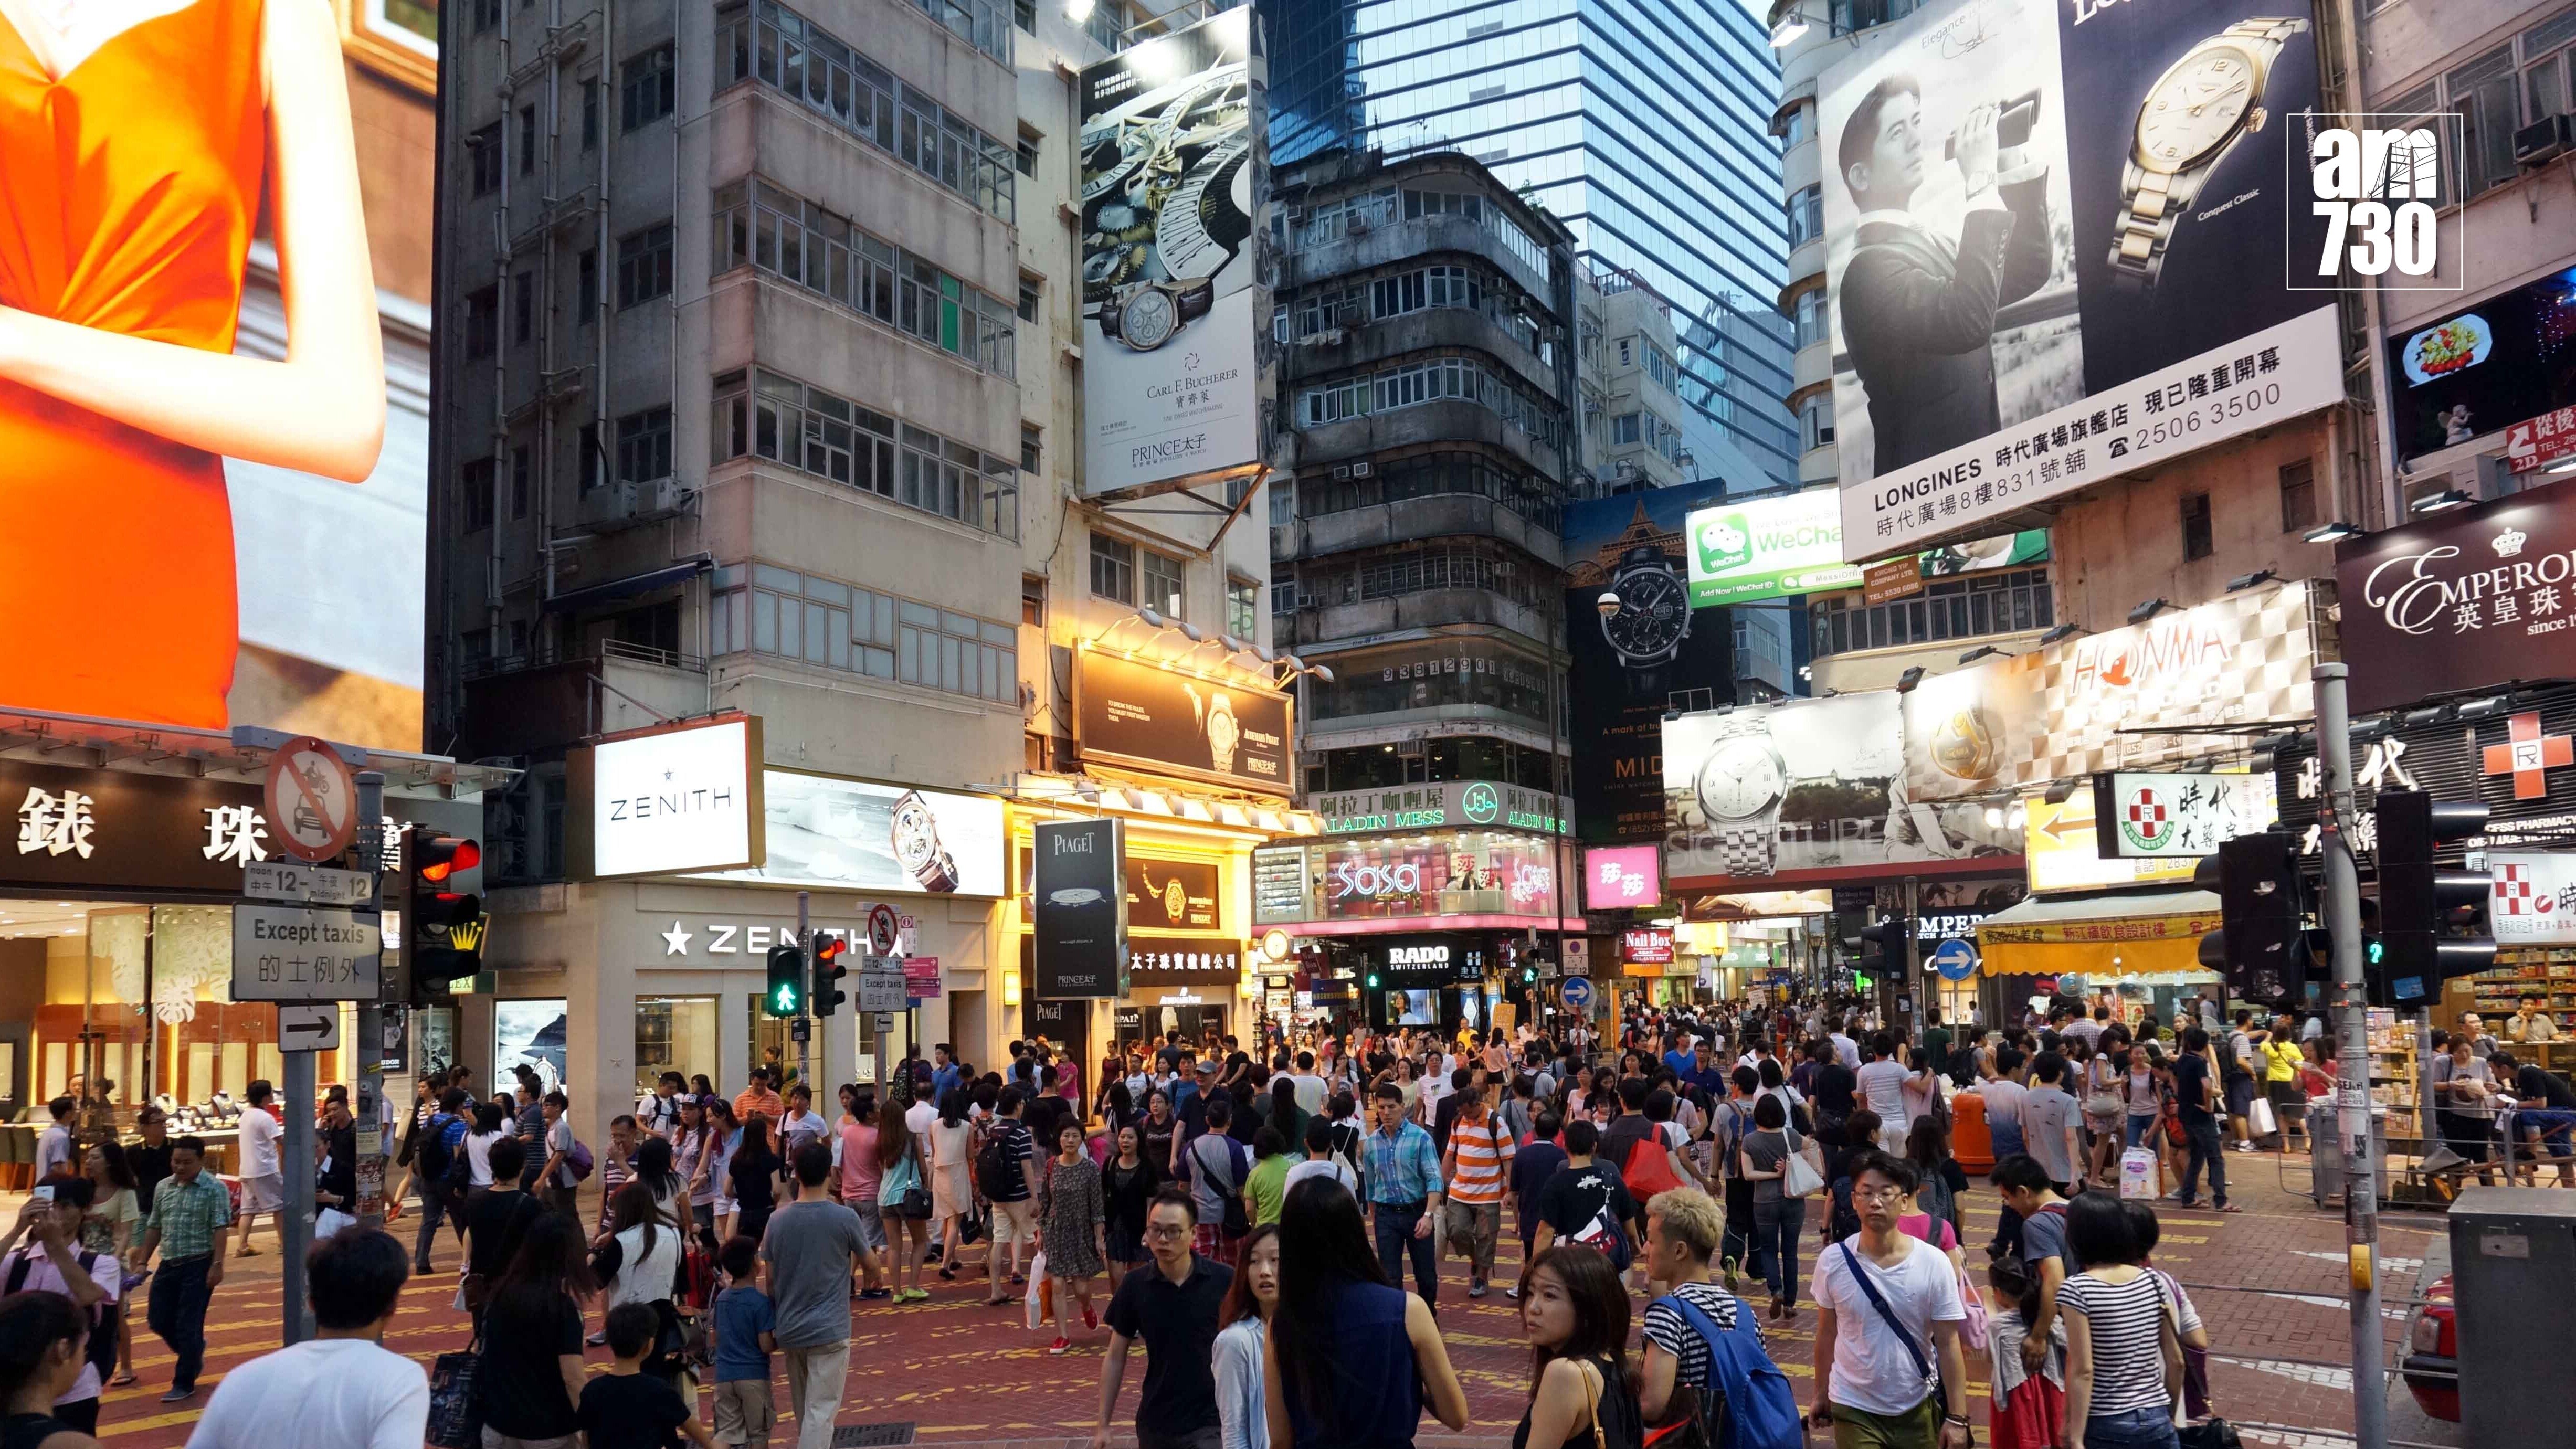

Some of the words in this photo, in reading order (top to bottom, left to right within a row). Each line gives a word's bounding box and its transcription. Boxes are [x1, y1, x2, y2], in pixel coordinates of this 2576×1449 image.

[2198, 199, 2233, 222] Conquest
[2234, 188, 2261, 205] Classic
[1147, 385, 1173, 399] CARL
[1185, 369, 1239, 390] BUCHERER
[2136, 410, 2201, 451] 2506
[2210, 383, 2281, 425] 3500
[1875, 458, 1982, 512] LONGINES
[2145, 345, 2281, 415] 現已隆重開幕
[1709, 553, 1745, 569] WeChat
[1699, 588, 1715, 598] Add
[1715, 587, 1731, 595] Now
[1736, 582, 1764, 593] WeChat
[1870, 573, 1900, 587] COMPANY
[1869, 593, 1884, 601] TEL:
[2453, 581, 2576, 635] 英皇珠
[2527, 615, 2567, 636] since
[610, 786, 731, 821] ZENITH
[2179, 779, 2237, 819] 時代
[1323, 814, 1387, 833] ALADIN
[1395, 809, 1444, 828] MESS
[1508, 811, 1542, 829] ALADIN
[1545, 816, 1567, 833] MES
[1054, 832, 1094, 856] PIAGET
[250, 867, 272, 876] noon
[251, 880, 272, 892] 中午
[310, 890, 346, 900] midnight
[349, 877, 367, 897] 12
[254, 918, 317, 945] Except
[322, 923, 364, 944] taxis
[1919, 914, 1996, 933] MPER
[708, 925, 872, 954] ZENTH
[1625, 932, 1648, 947] Nail
[1650, 932, 1671, 947] Box
[895, 960, 902, 969] 12
[1389, 946, 1449, 964] RADO
[259, 954, 360, 984] 的士例外
[865, 978, 885, 991] Except
[887, 979, 901, 988] taxis
[1036, 1003, 1063, 1021] PIAGET
